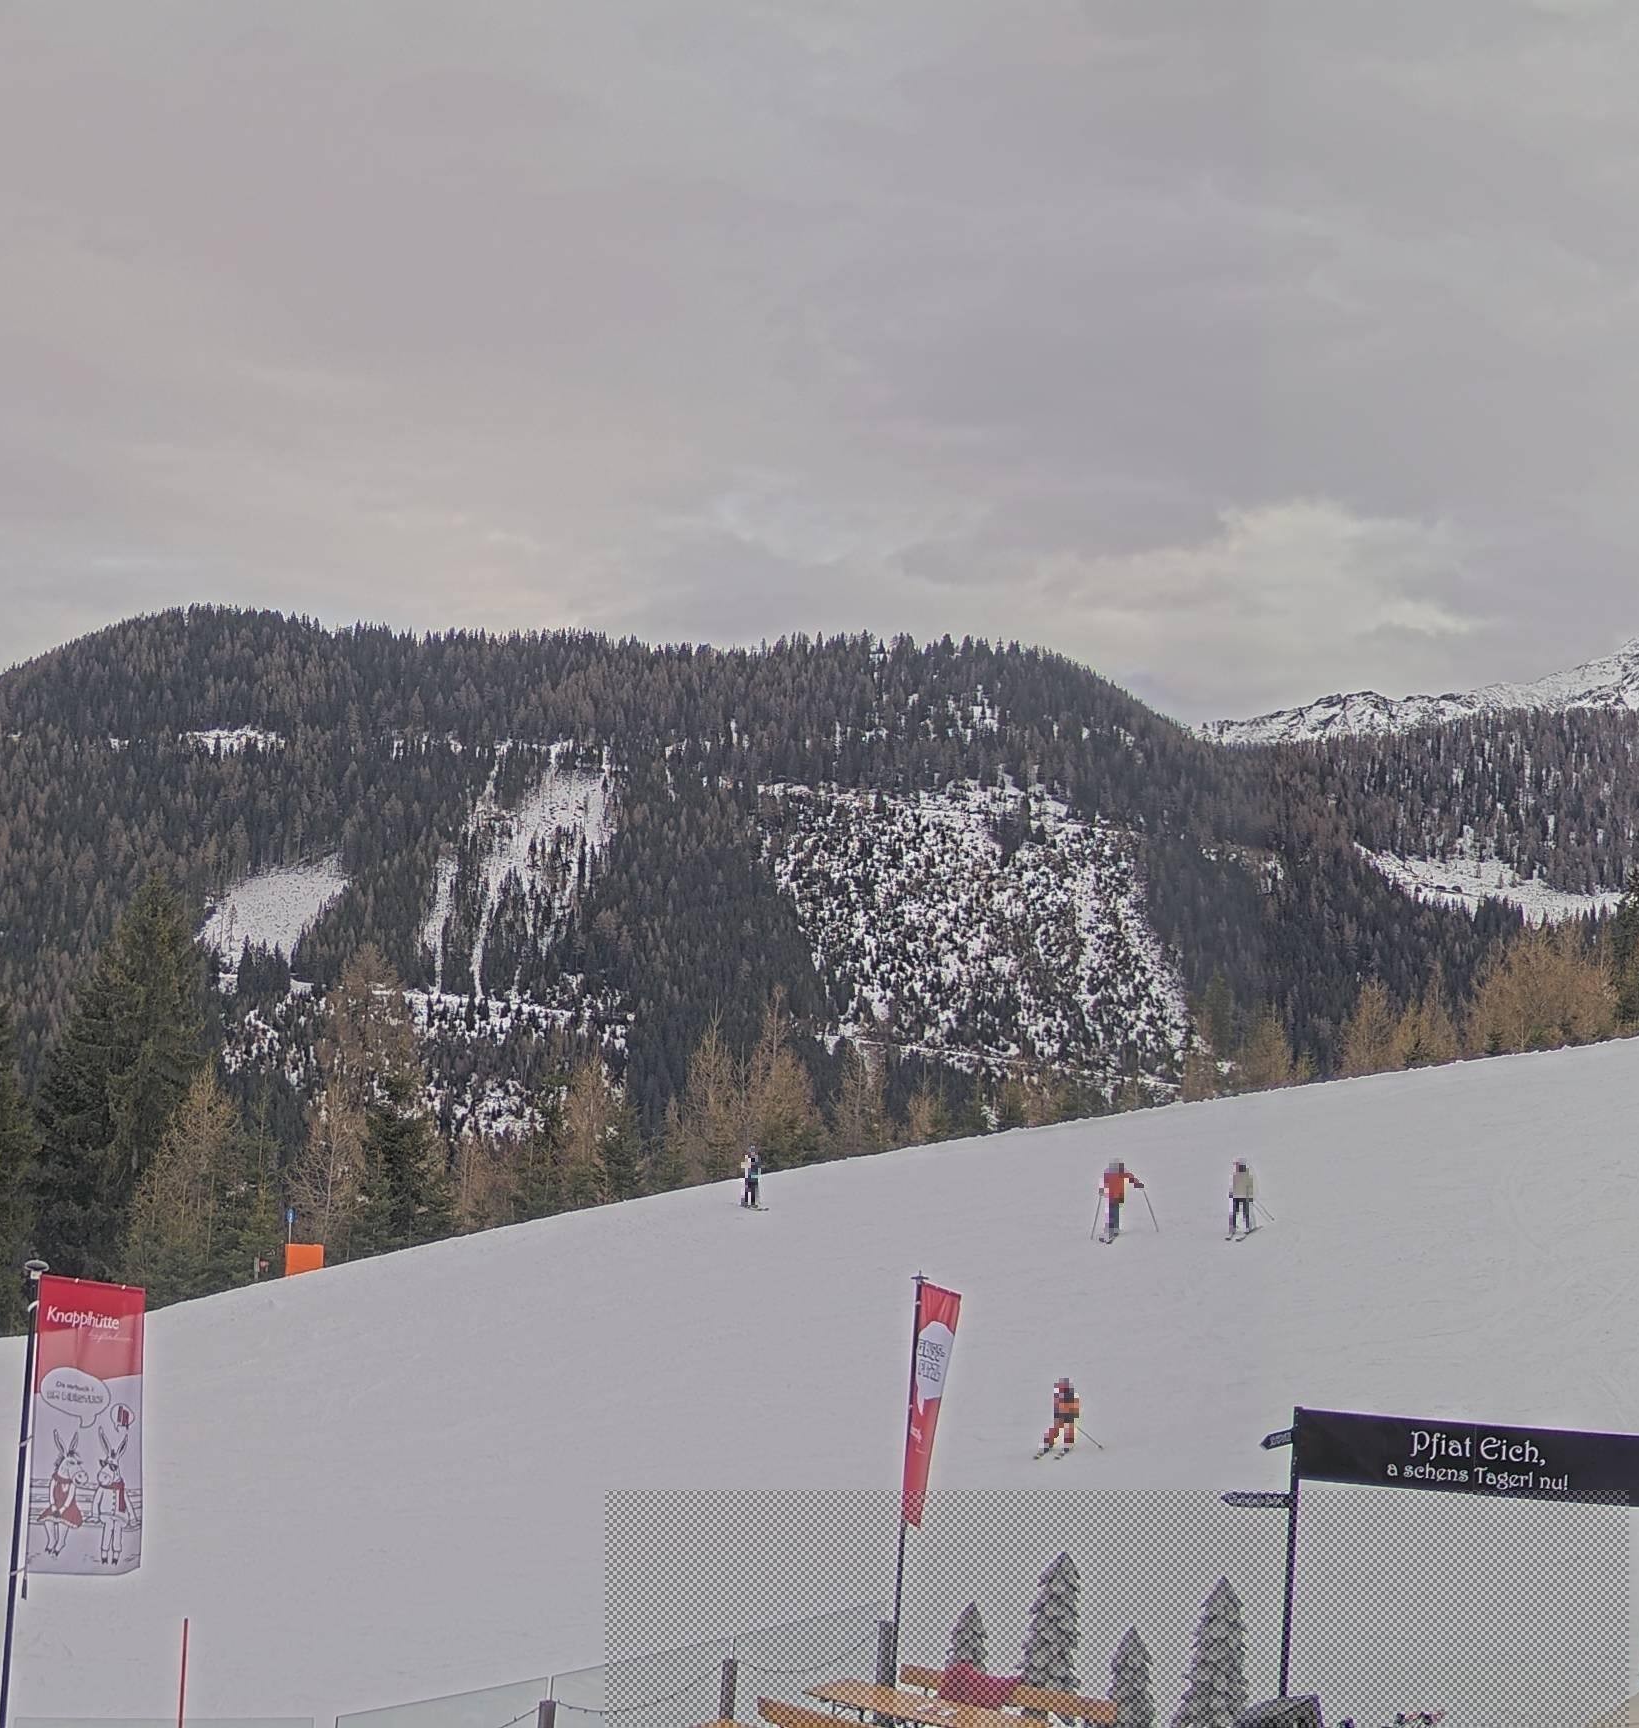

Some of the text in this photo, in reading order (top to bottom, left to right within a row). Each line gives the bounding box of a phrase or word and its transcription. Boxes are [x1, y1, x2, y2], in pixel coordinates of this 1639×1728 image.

[46, 1305, 120, 1330] Knapplhütte
[1409, 1430, 1547, 1467] Pfiat Eich,
[1386, 1462, 1570, 1491] a schens Tagerl nu!
